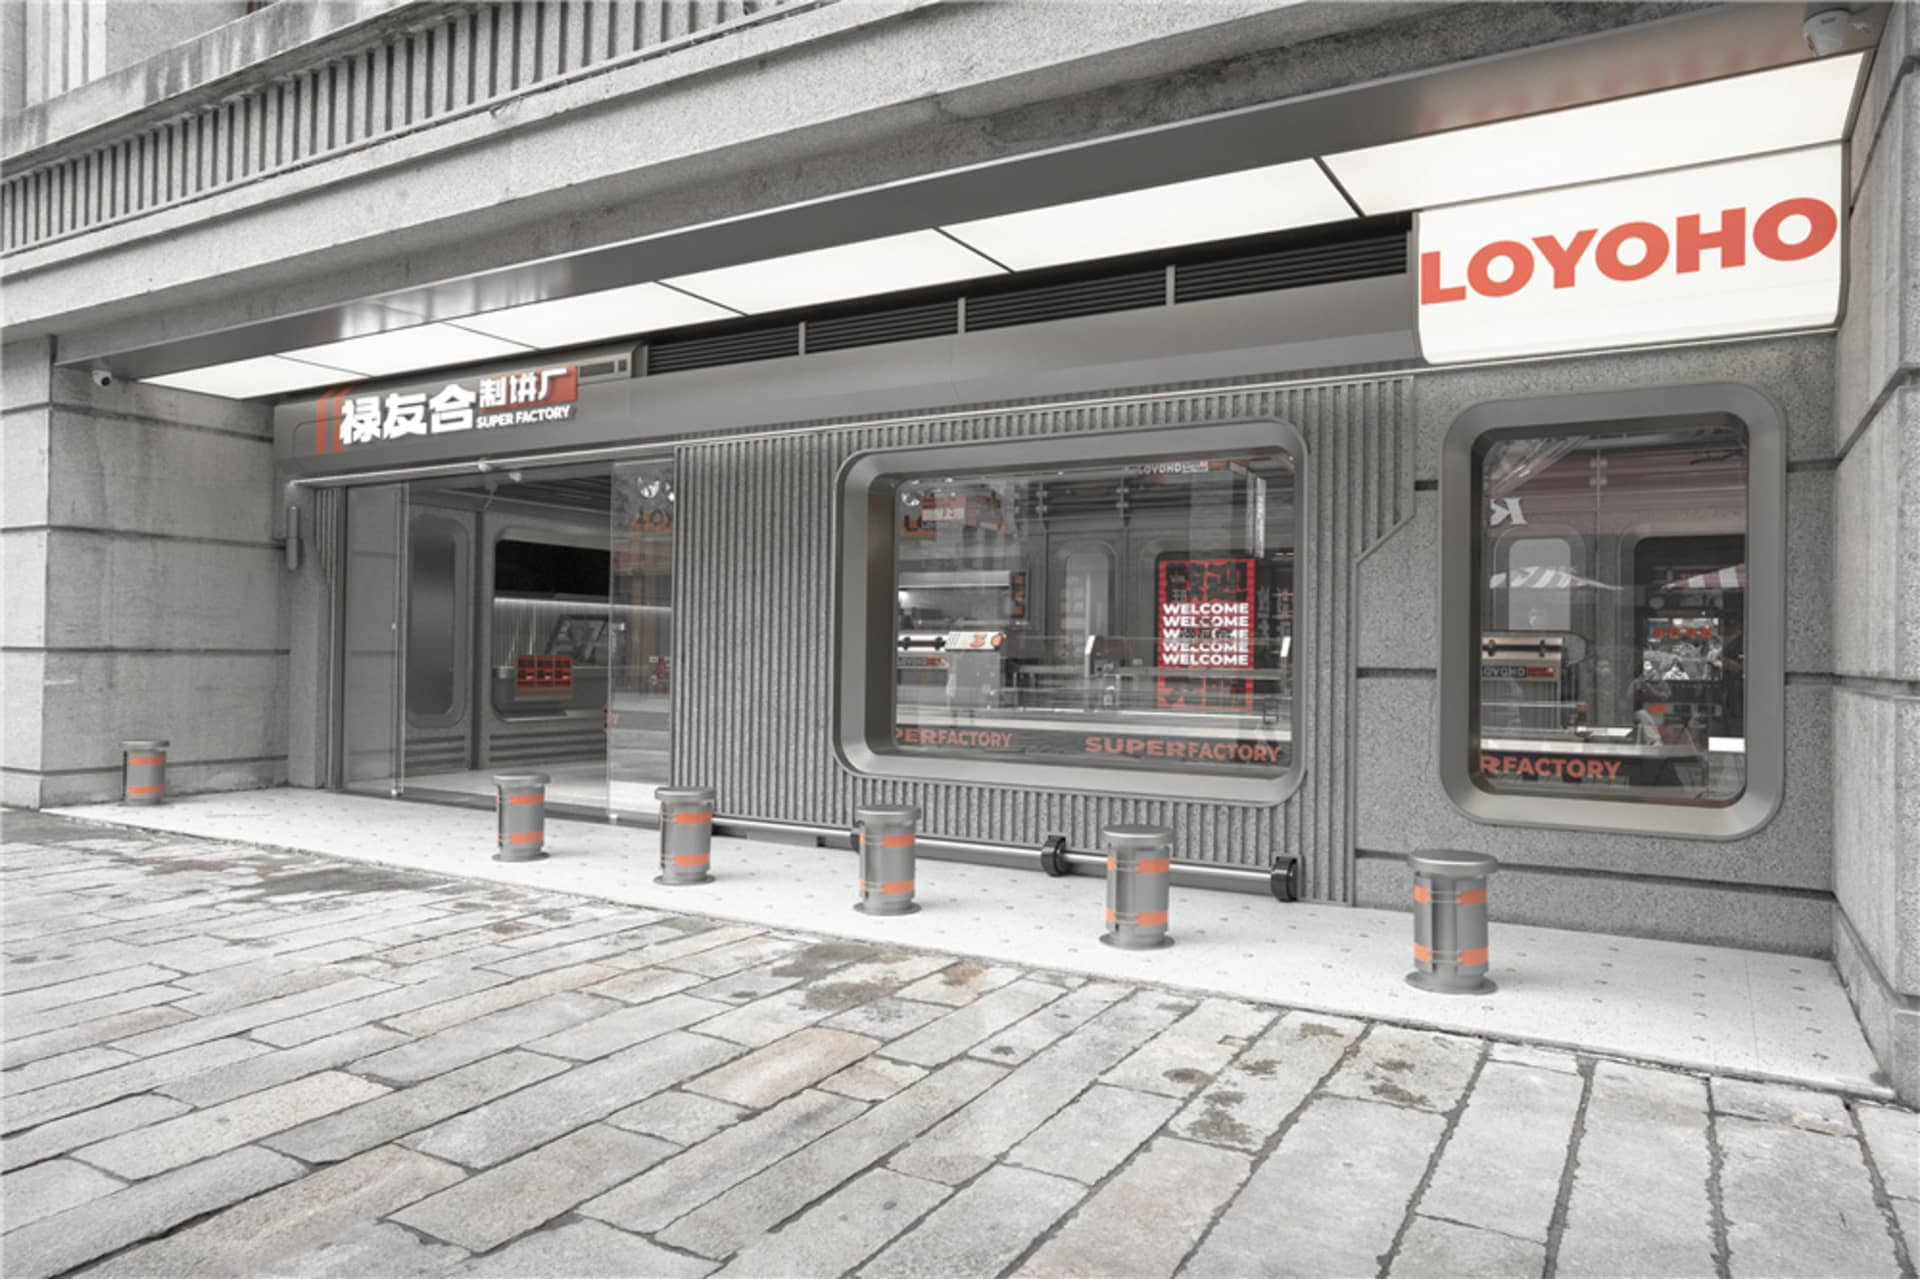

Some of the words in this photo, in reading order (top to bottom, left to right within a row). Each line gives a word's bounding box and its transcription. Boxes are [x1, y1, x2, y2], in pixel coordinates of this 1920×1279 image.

[1421, 197, 1838, 305] LOYOHO
[339, 383, 477, 445] 禄友合
[476, 414, 514, 429] SUPER
[515, 404, 571, 425] FACTORY
[1162, 602, 1249, 614] WELCOME
[1162, 615, 1249, 627] WELCOME
[1162, 654, 1249, 666] WELCOME
